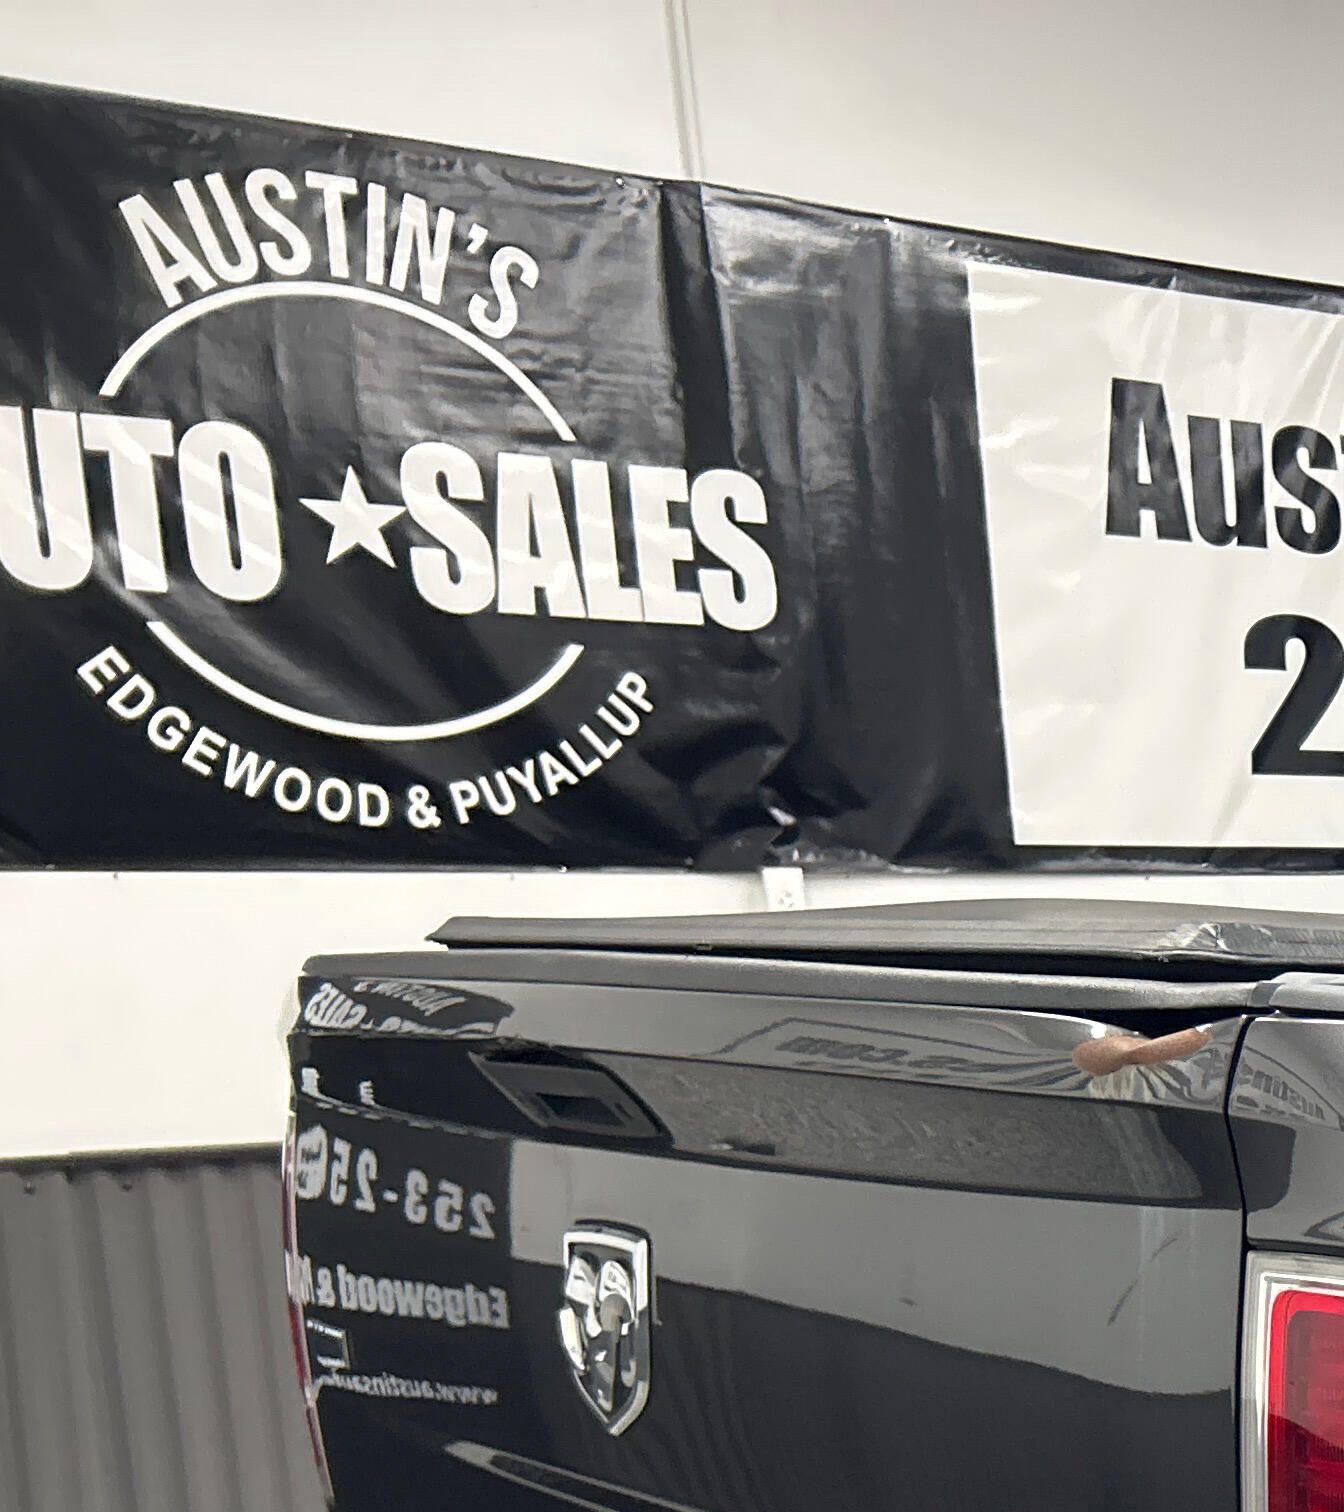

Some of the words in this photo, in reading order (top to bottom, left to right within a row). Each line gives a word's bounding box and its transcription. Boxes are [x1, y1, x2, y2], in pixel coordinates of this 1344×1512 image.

[118, 168, 540, 340] AUSTIN'S
[0, 406, 283, 601] UTO
[399, 441, 778, 631] SALES
[76, 645, 391, 828] EDGEWOOD
[407, 786, 442, 829] &
[451, 670, 655, 824] PUYALLUP
